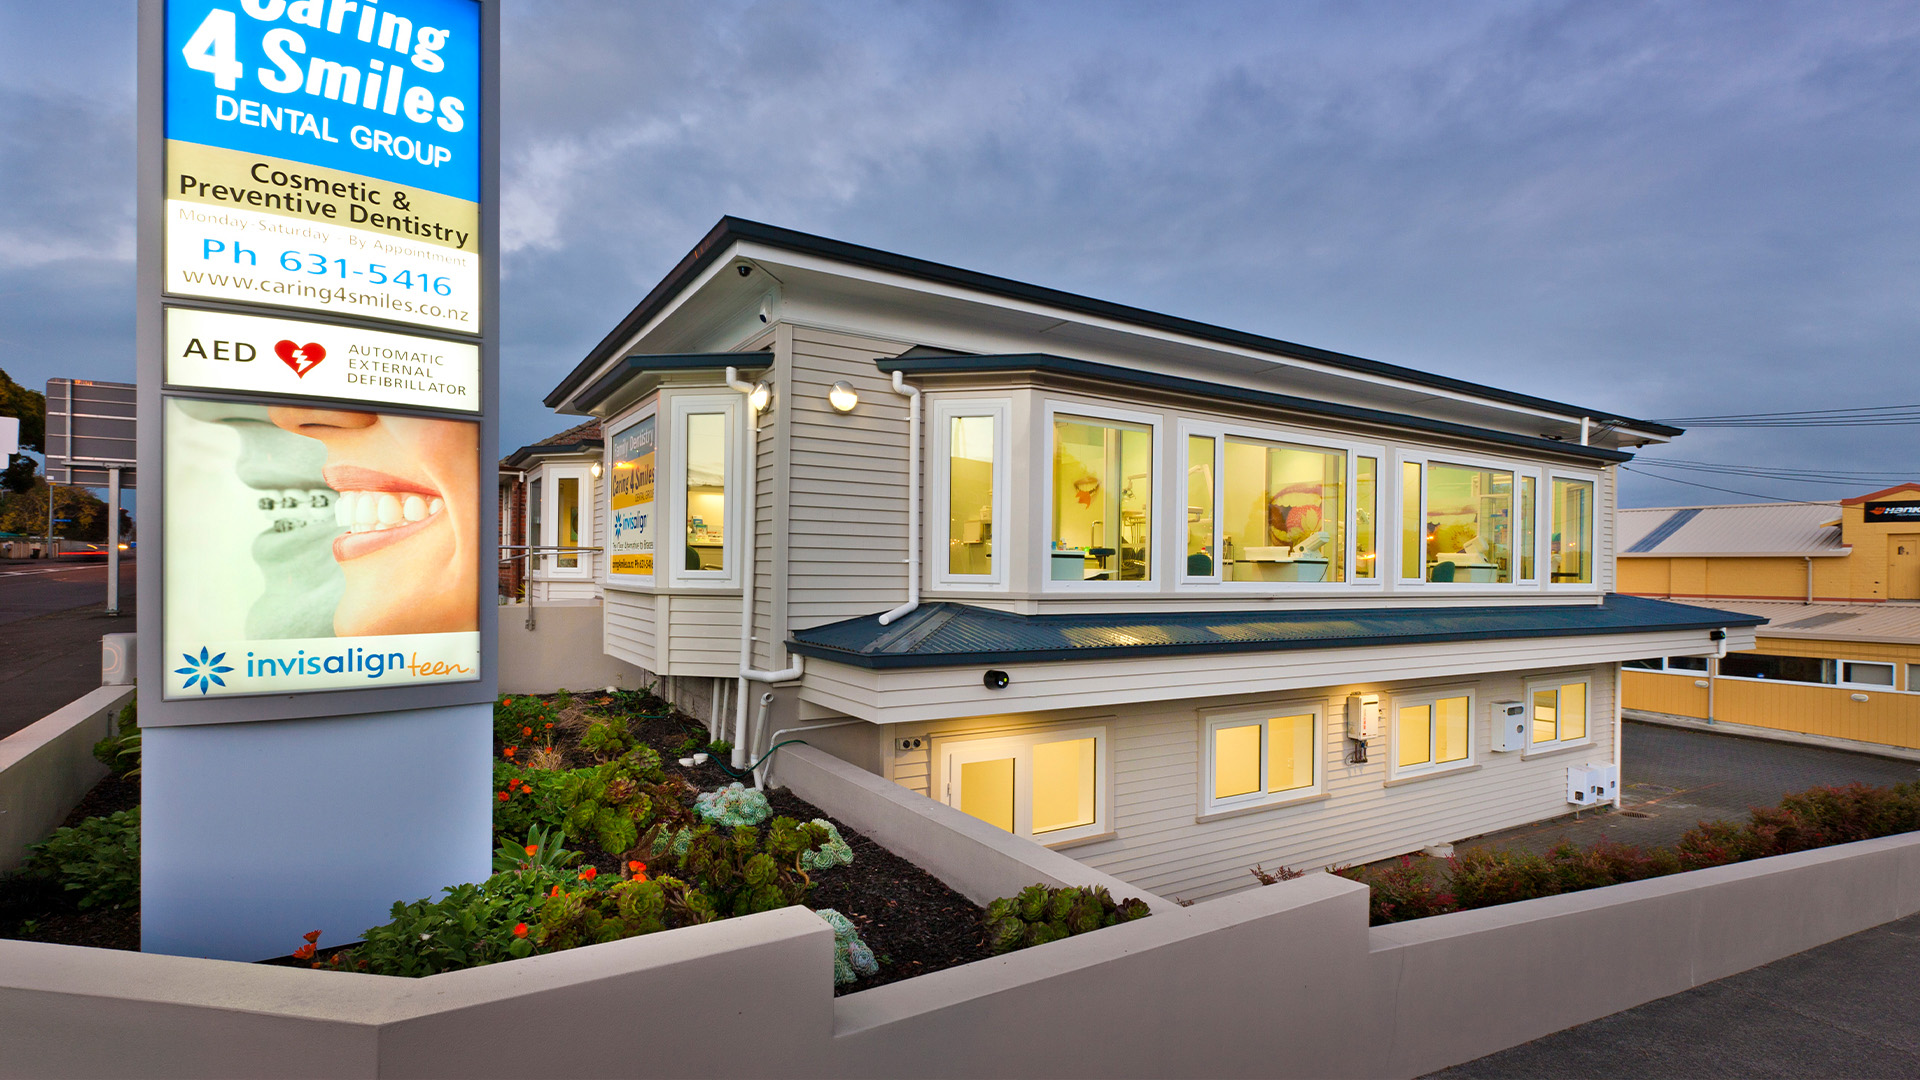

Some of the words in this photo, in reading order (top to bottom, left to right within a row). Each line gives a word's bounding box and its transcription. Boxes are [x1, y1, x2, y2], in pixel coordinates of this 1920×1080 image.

[182, 8, 243, 91] 4
[258, 28, 465, 133] Smiles
[216, 95, 338, 143] DENTAL
[350, 124, 452, 168] GROUP
[251, 163, 381, 205] Cosmetic
[393, 191, 411, 211] &
[180, 174, 337, 218] Preventive
[350, 205, 469, 249] Dentistry
[203, 238, 257, 266] Ph
[280, 250, 452, 296] 631-5416
[349, 234, 367, 250] By
[373, 239, 467, 268] Appointment
[183, 270, 469, 322] www.caring4smiles.co.nz
[183, 338, 257, 362] AED
[349, 344, 444, 366] AUTOMATIC
[347, 372, 467, 396] DEFIBRILLATOR
[349, 358, 433, 378] EXTERNAL
[614, 438, 628, 457] Family
[629, 428, 653, 451] Dentistry
[613, 474, 629, 497] Caring
[630, 469, 634, 493] 4
[635, 464, 655, 490] Smiles
[623, 510, 647, 534] invisalign
[247, 648, 405, 679] invisalign
[407, 652, 469, 677] teen
